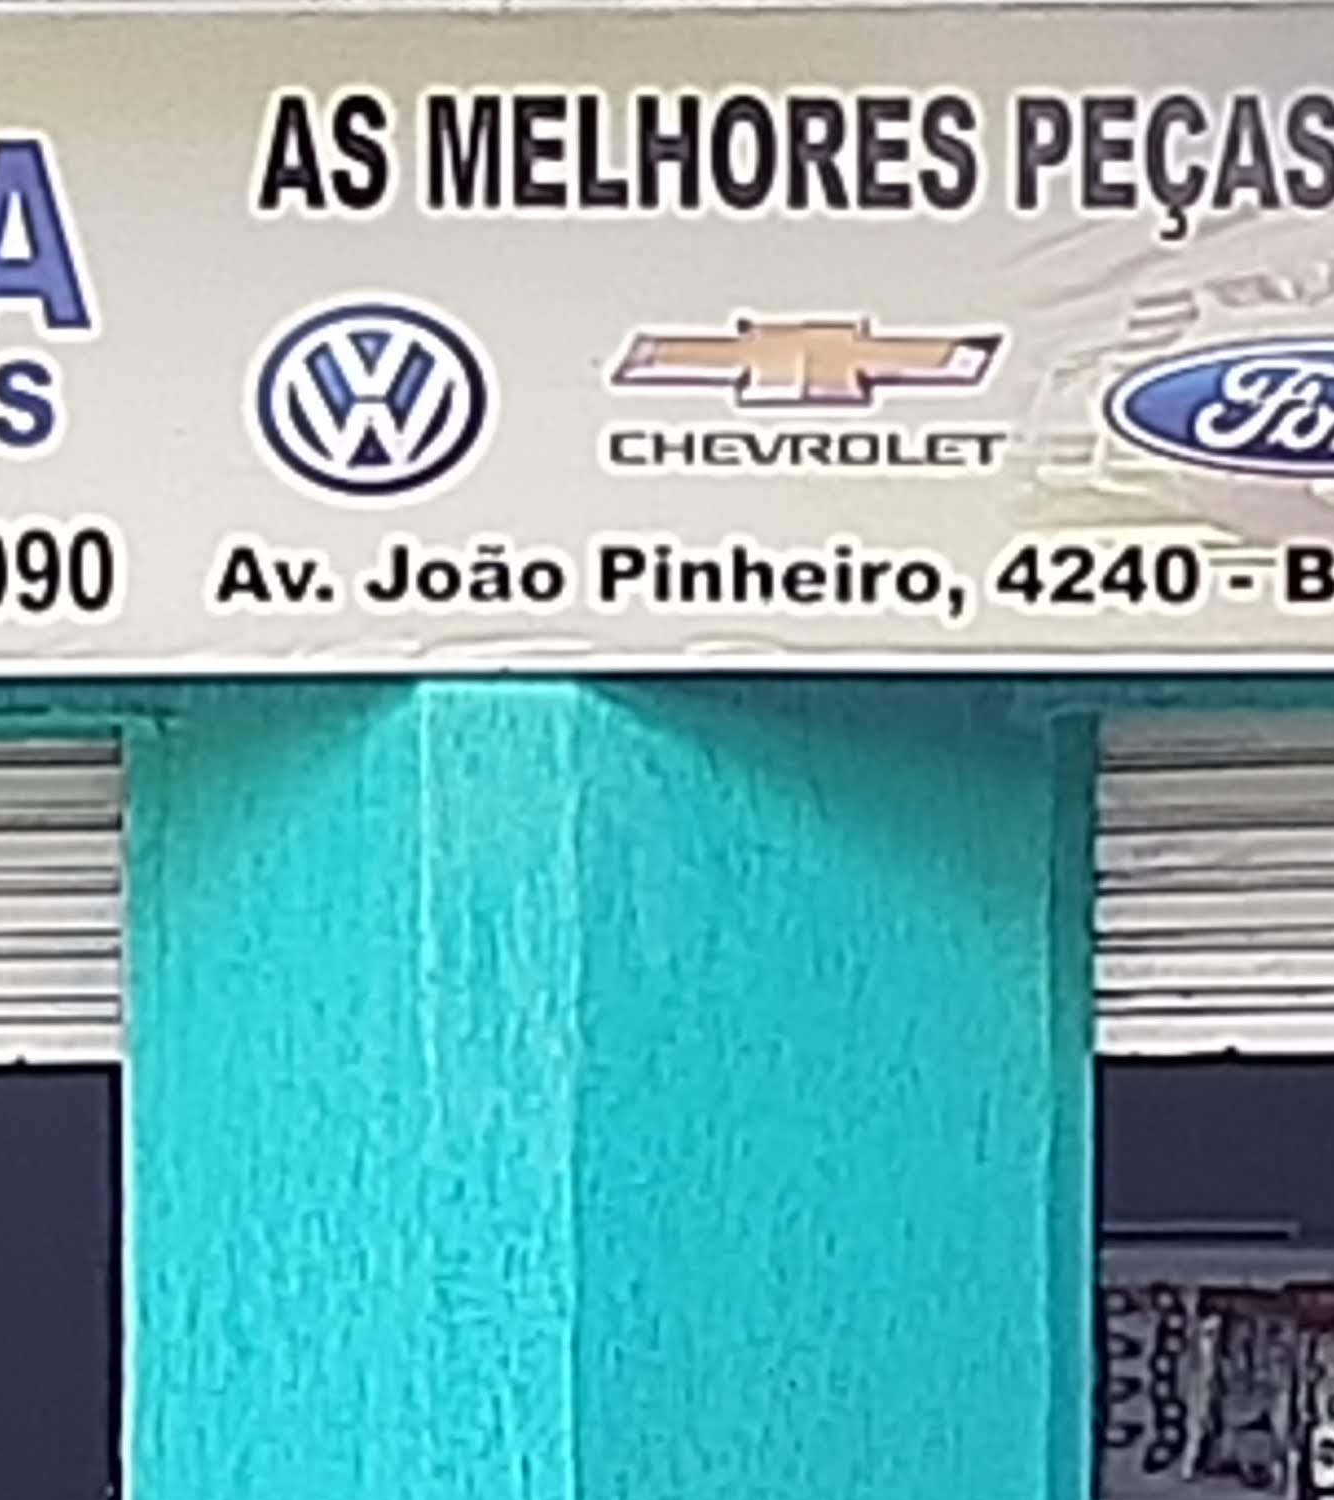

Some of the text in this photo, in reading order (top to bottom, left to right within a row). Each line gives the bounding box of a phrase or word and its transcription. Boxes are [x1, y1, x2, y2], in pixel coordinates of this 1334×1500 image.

[257, 94, 390, 212] AS
[427, 94, 979, 212] MELHORES
[609, 432, 1007, 467] CHEVROLET
[217, 546, 334, 603] Av.
[366, 543, 565, 603] João
[599, 545, 964, 618] Pinheiro,
[996, 546, 1198, 603] 4240
